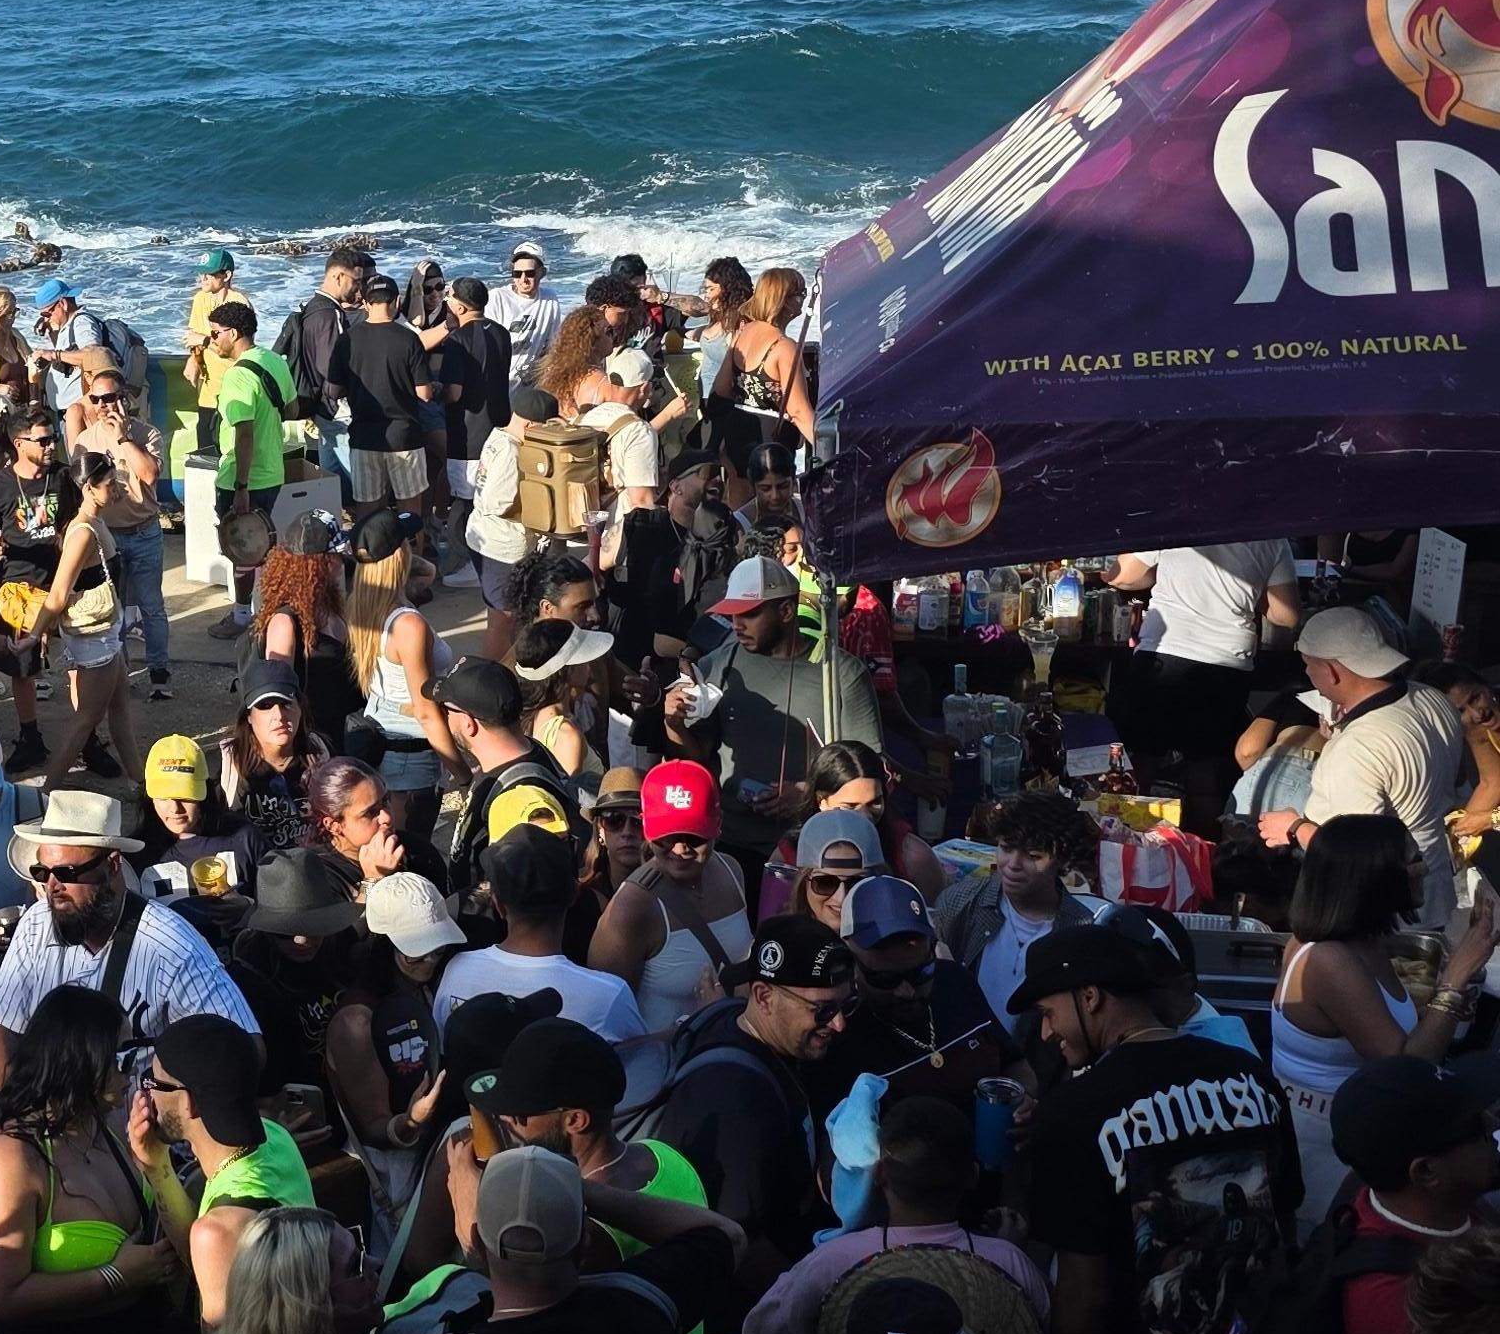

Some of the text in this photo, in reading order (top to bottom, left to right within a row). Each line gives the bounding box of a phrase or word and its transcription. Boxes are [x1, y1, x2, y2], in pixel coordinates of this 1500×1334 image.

[985, 334, 1468, 376] WITH AÇAI BERRY 100% NATURAL
